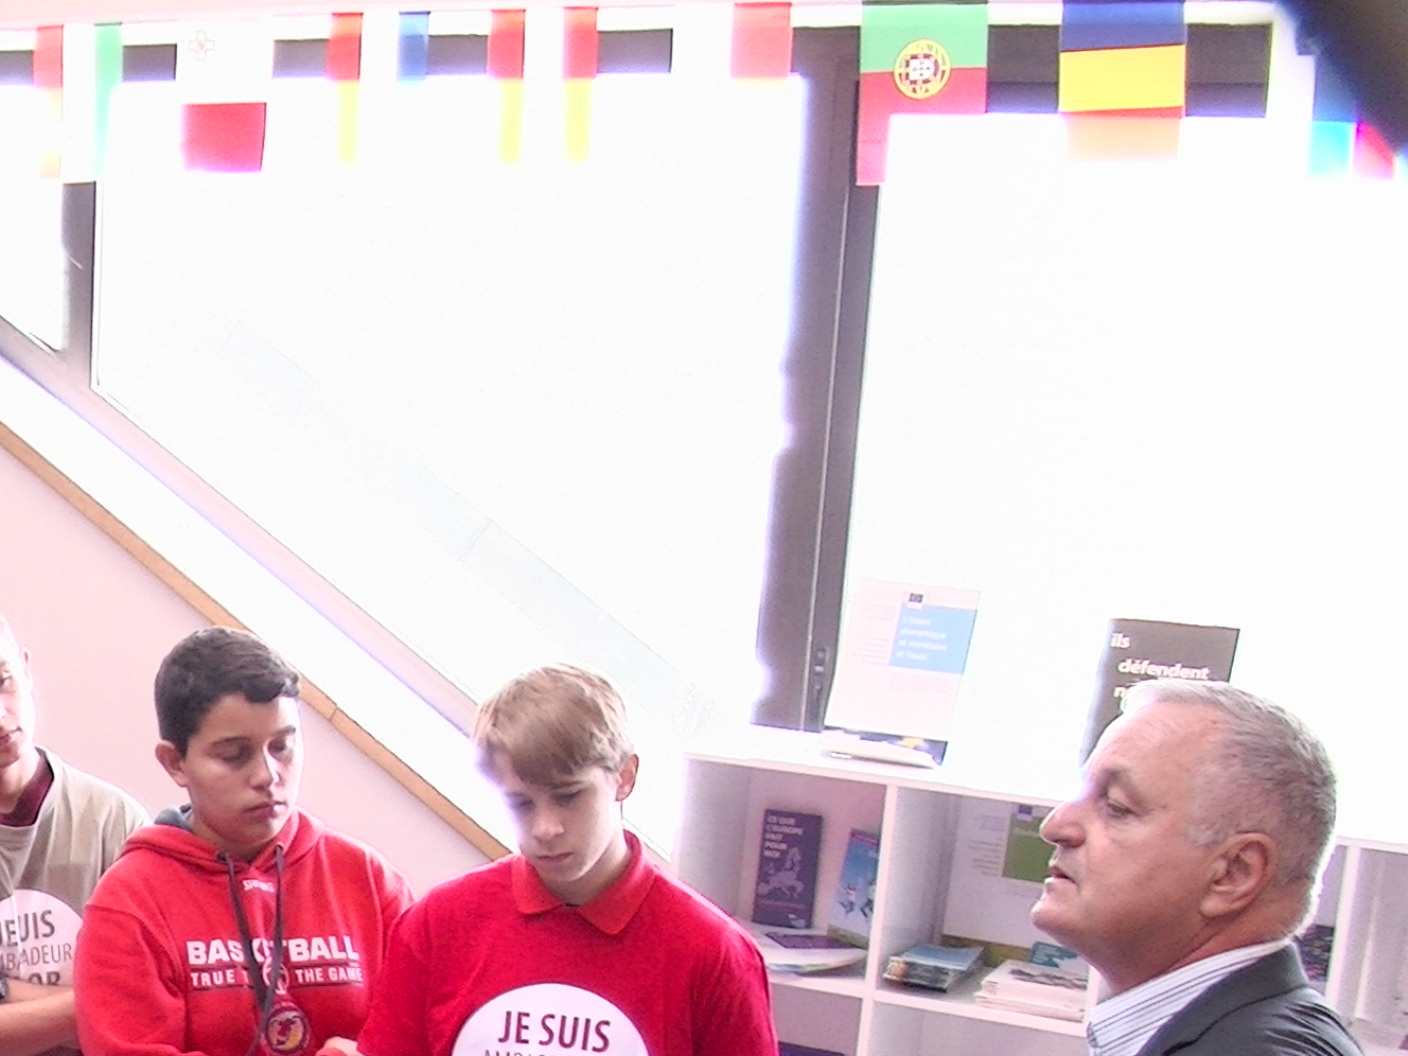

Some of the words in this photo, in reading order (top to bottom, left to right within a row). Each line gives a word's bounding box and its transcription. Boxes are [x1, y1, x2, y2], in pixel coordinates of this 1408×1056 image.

[1109, 632, 1130, 649] ils
[1117, 658, 1211, 681] défendent
[18, 909, 55, 943] UIS
[189, 969, 236, 987] TRUE
[295, 967, 324, 983] THE
[498, 1010, 531, 1044] JE
[539, 1013, 611, 1053] SUIS
